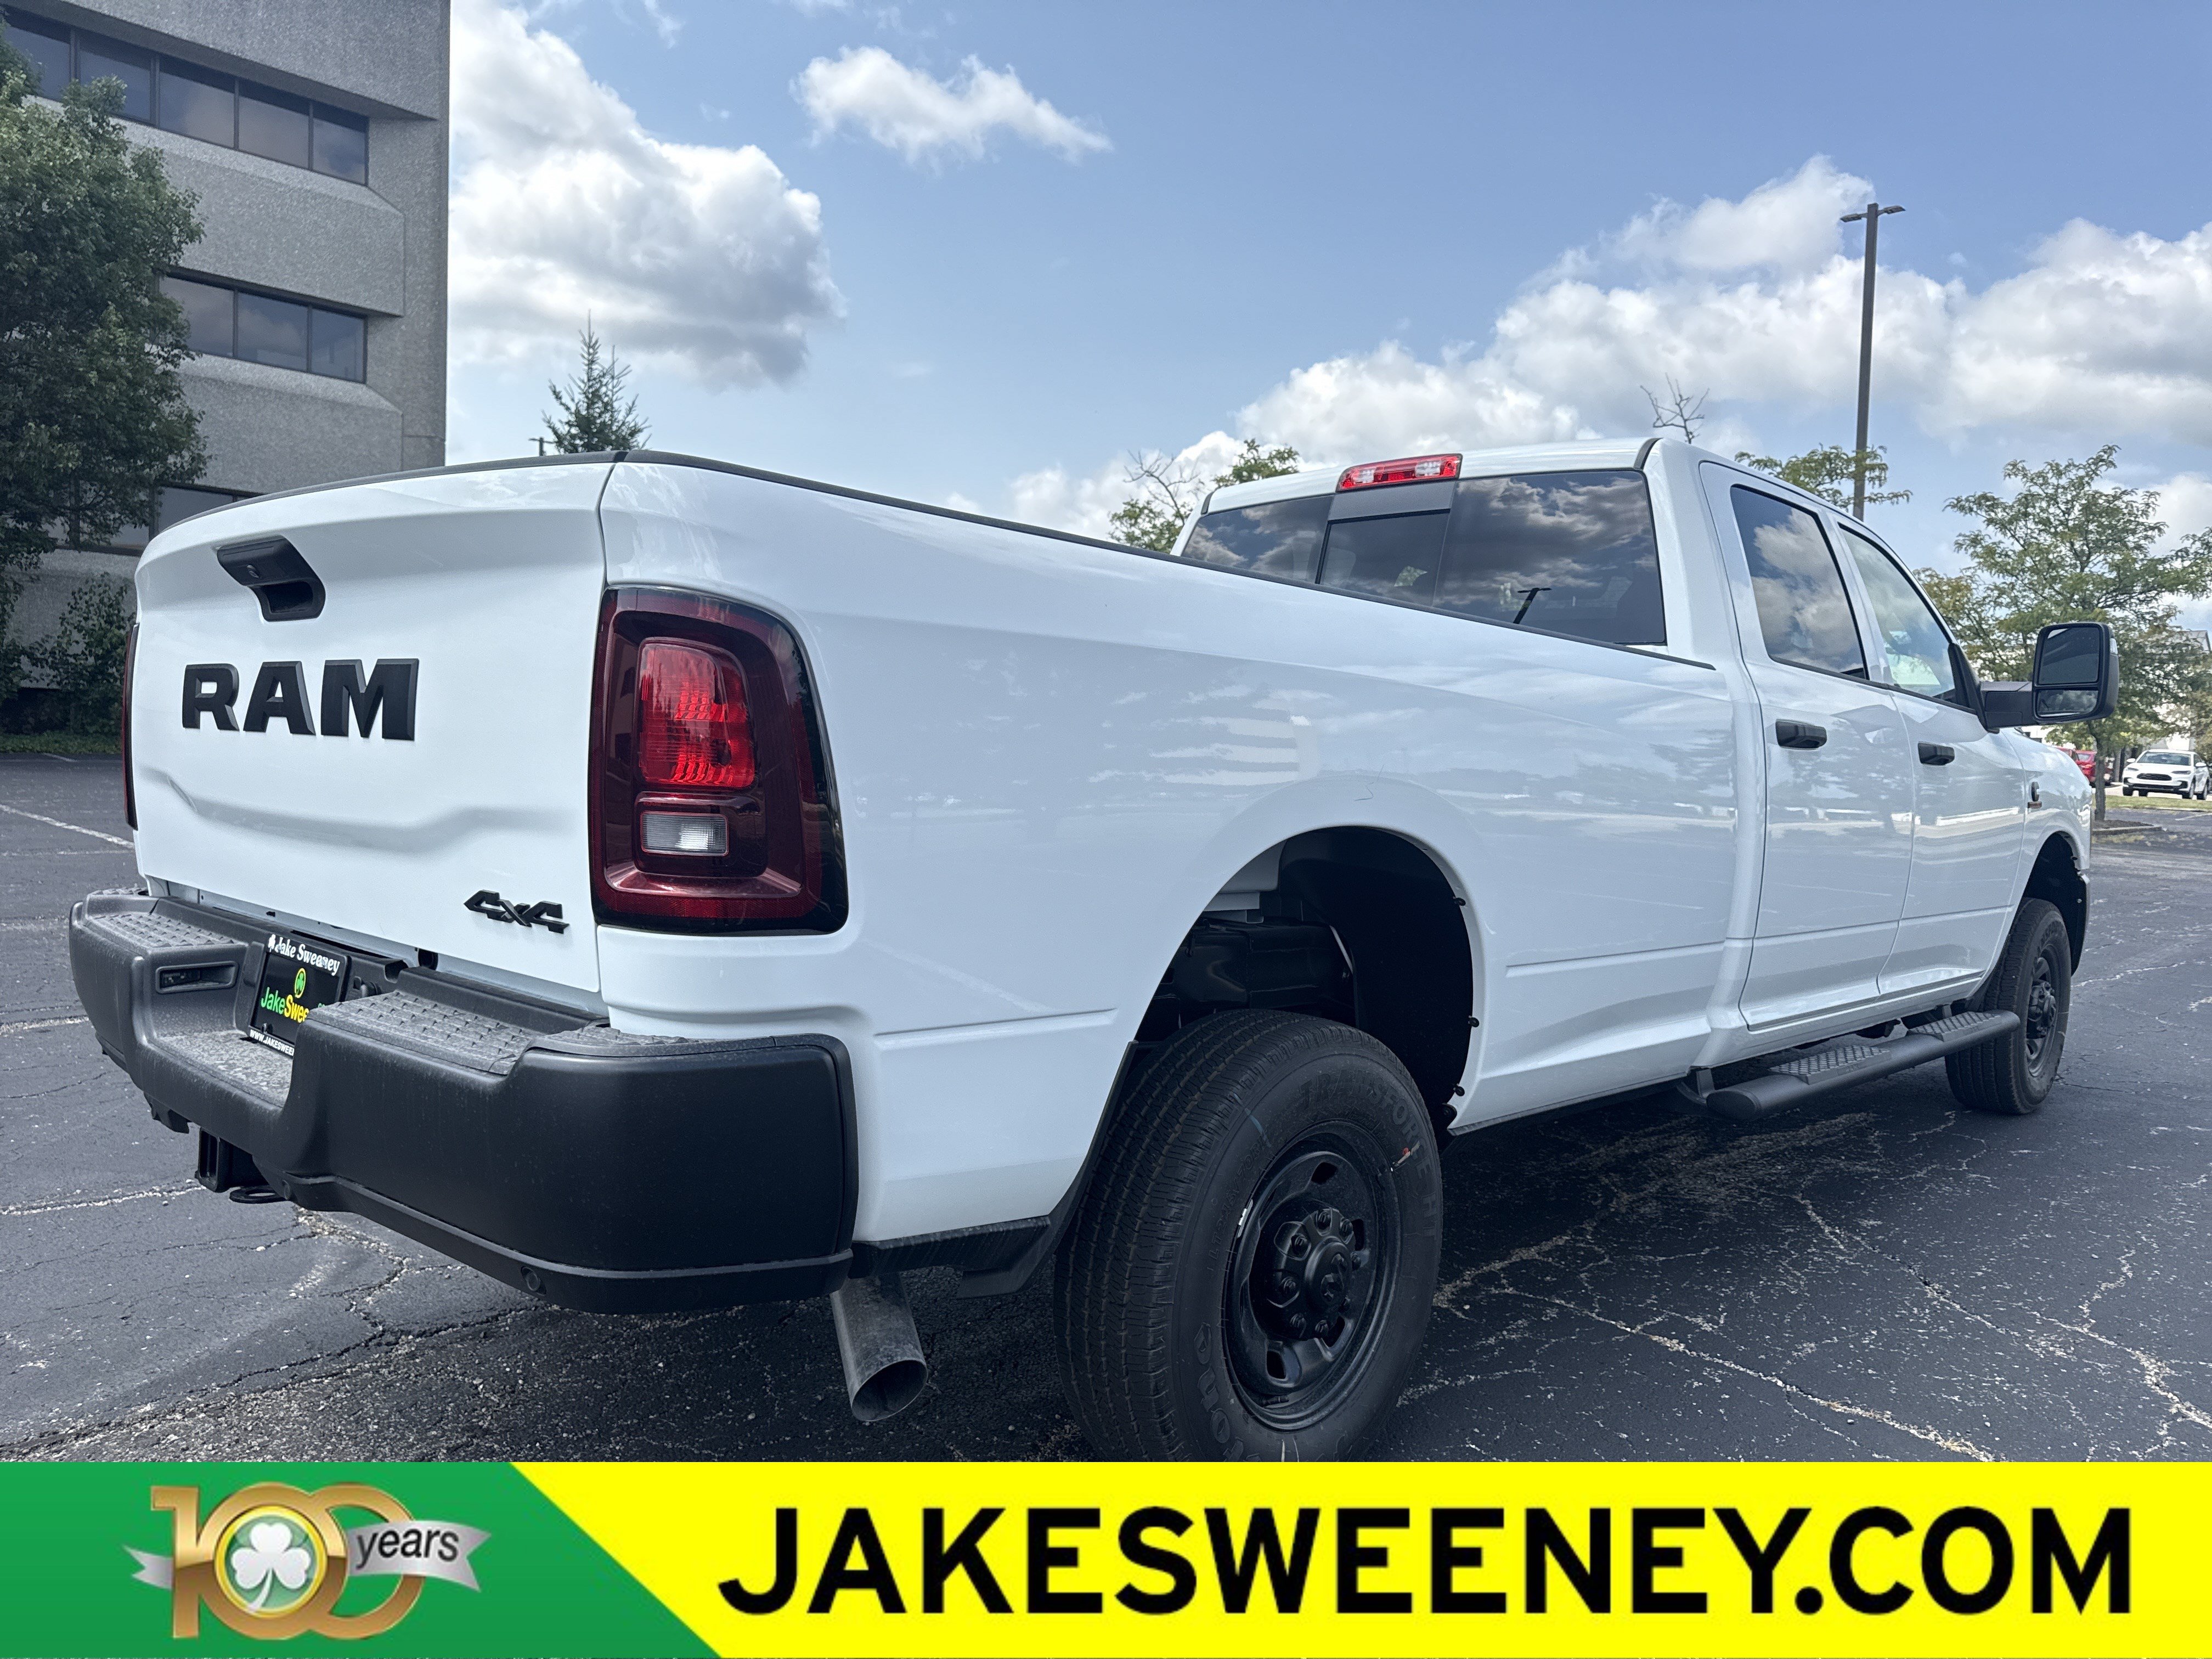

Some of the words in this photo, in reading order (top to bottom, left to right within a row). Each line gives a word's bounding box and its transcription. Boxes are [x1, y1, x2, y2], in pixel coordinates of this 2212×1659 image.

[182, 658, 419, 741] RAM
[275, 936, 295, 957] Jake
[297, 943, 340, 976] Sweeney
